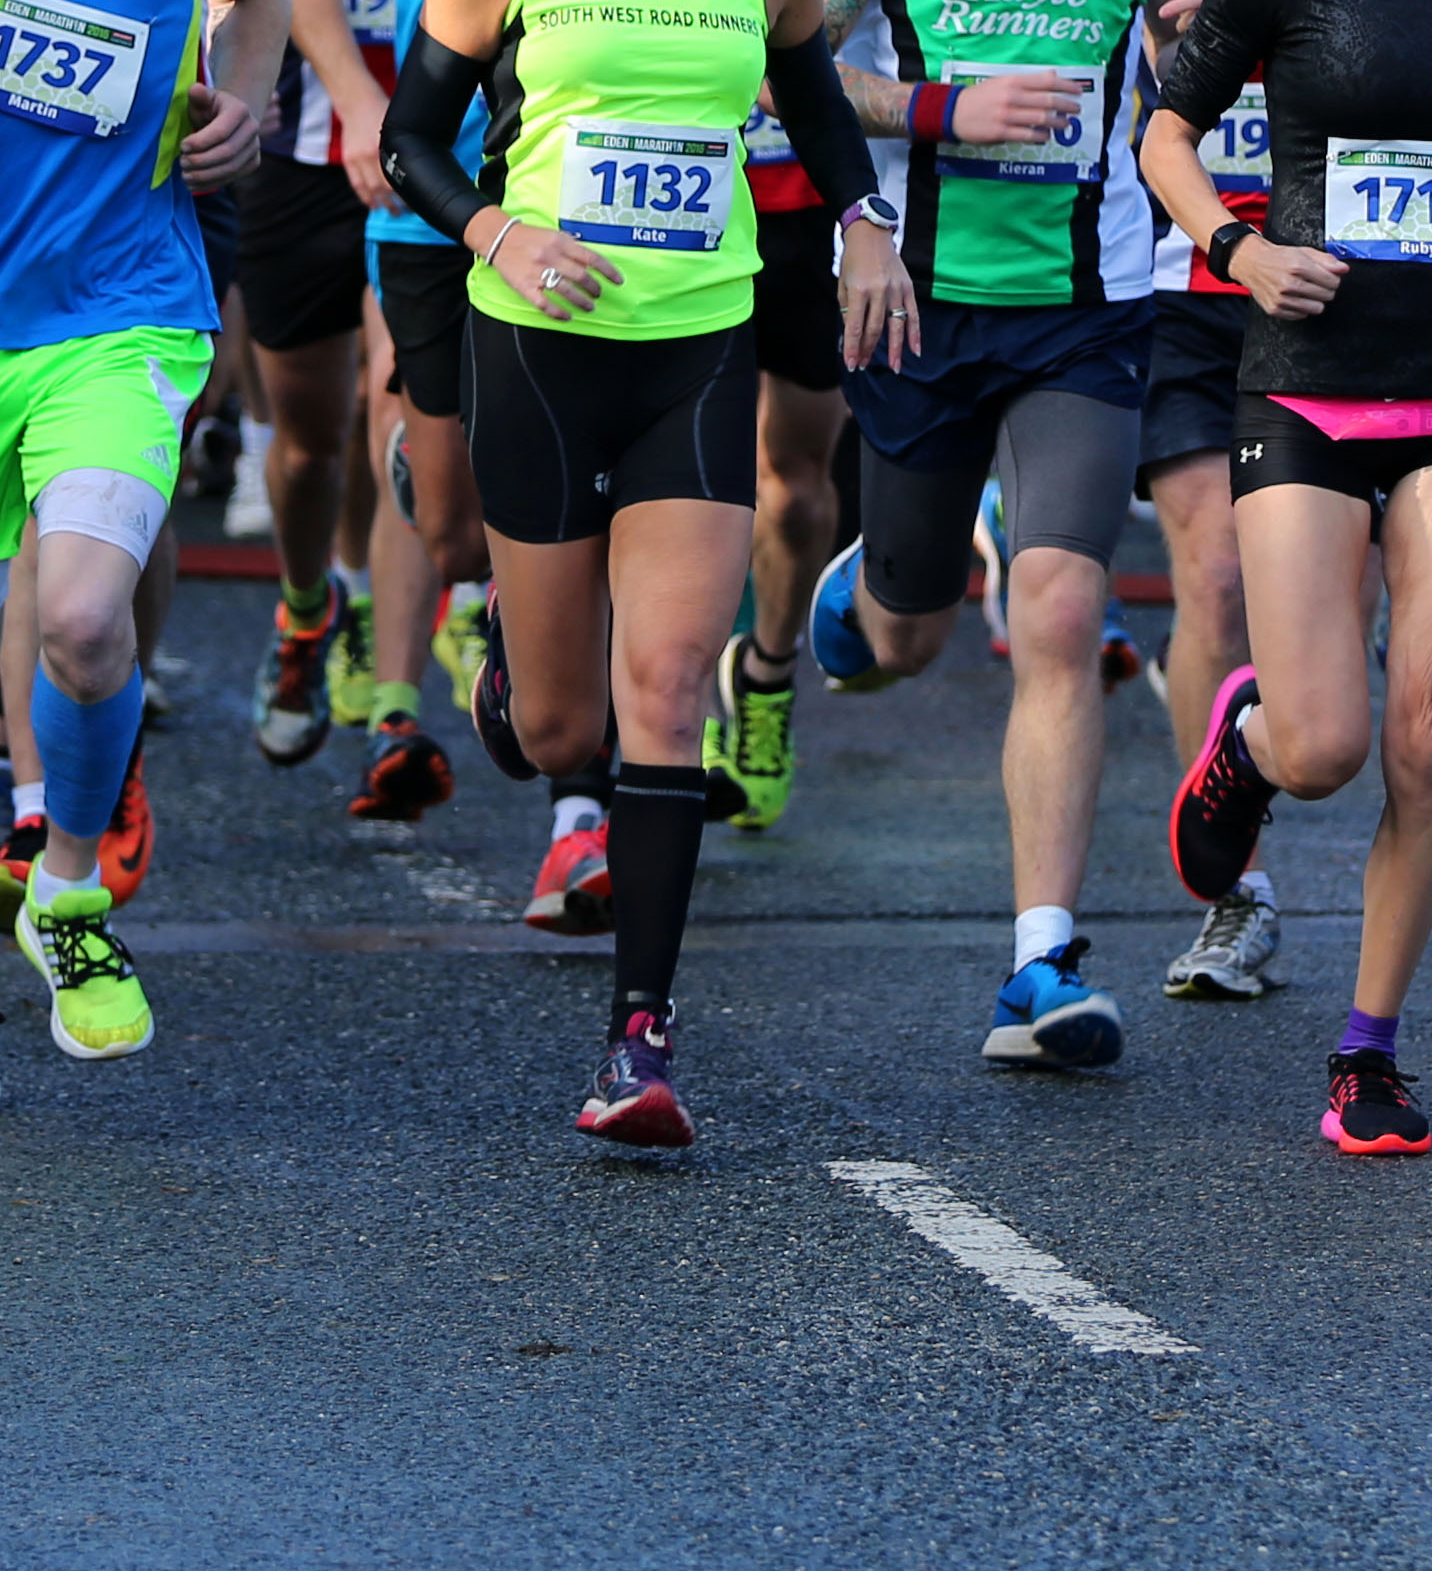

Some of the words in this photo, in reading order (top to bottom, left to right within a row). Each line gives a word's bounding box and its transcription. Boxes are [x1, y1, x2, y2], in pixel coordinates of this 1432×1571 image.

[4, 0, 31, 17] EDEN
[539, 7, 593, 30] SOUTH
[599, 7, 643, 25] WEST
[650, 9, 693, 27] ROAD
[699, 12, 759, 37] RUNNERS
[8, 94, 58, 119] Martin
[603, 135, 629, 149] EDEN
[1364, 152, 1390, 164] EDEN
[999, 162, 1045, 176] Kieran
[591, 160, 712, 213] 1132
[632, 228, 667, 243] Kate
